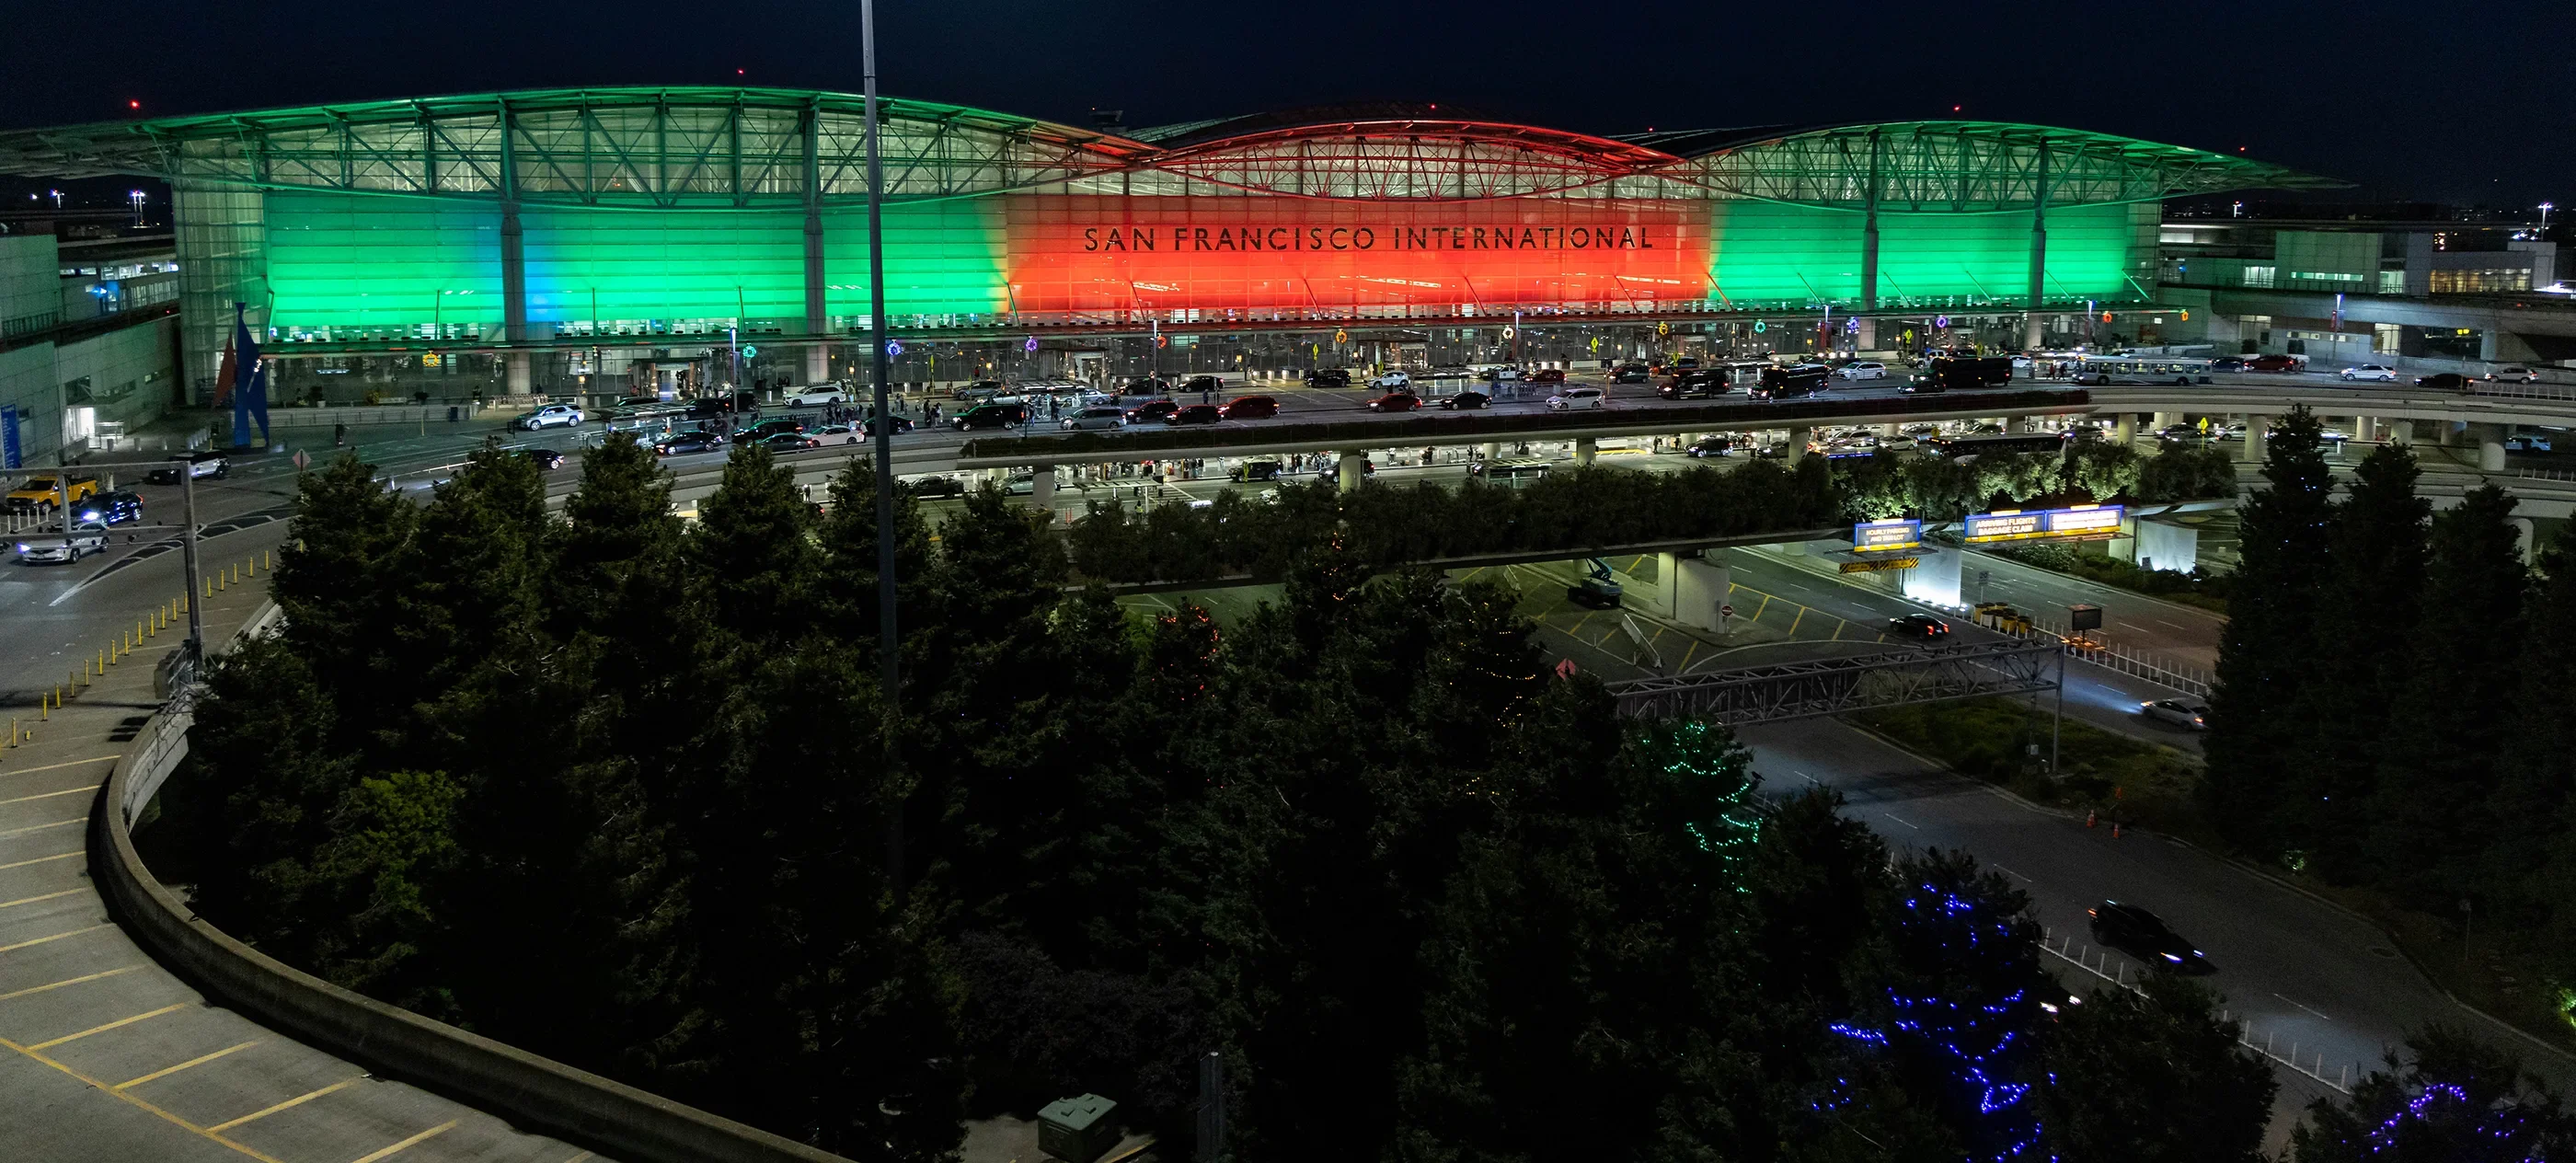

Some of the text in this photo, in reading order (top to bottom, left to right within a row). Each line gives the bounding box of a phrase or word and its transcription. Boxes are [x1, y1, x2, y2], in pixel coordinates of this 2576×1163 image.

[1085, 226, 1653, 252] SAN FRANCISCO INTERNATIONAL
[2008, 517, 2036, 525] FLIGHTS
[1977, 524, 2033, 535] BAGGAGE CLAIM
